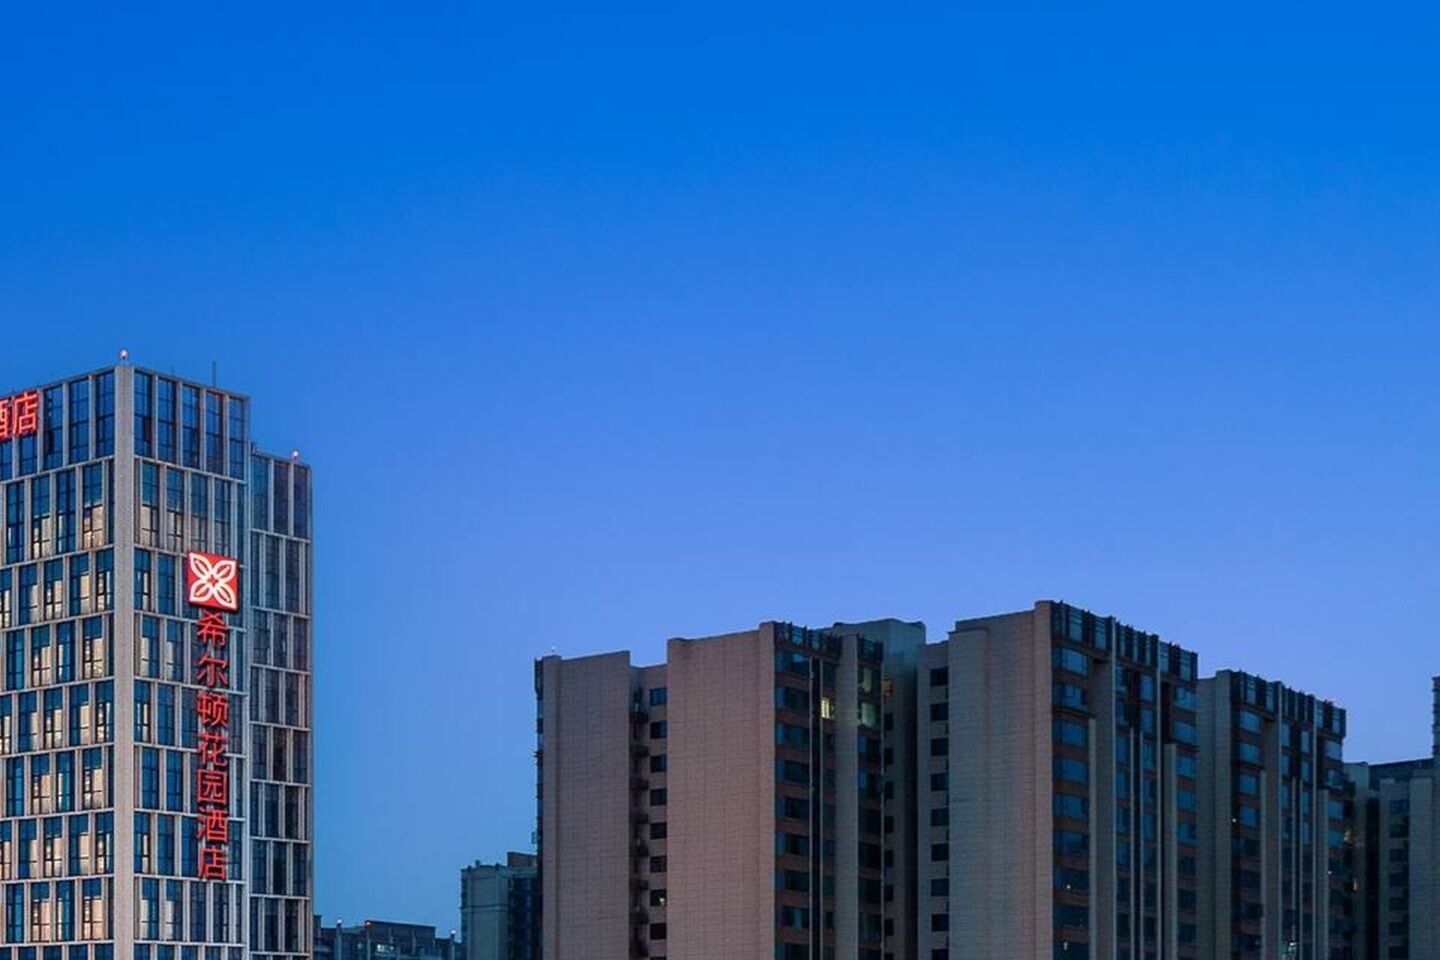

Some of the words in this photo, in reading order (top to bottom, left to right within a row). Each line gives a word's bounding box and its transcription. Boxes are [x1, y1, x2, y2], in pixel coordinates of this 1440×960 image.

[196, 612, 228, 881] 希尔顿花园酒店
